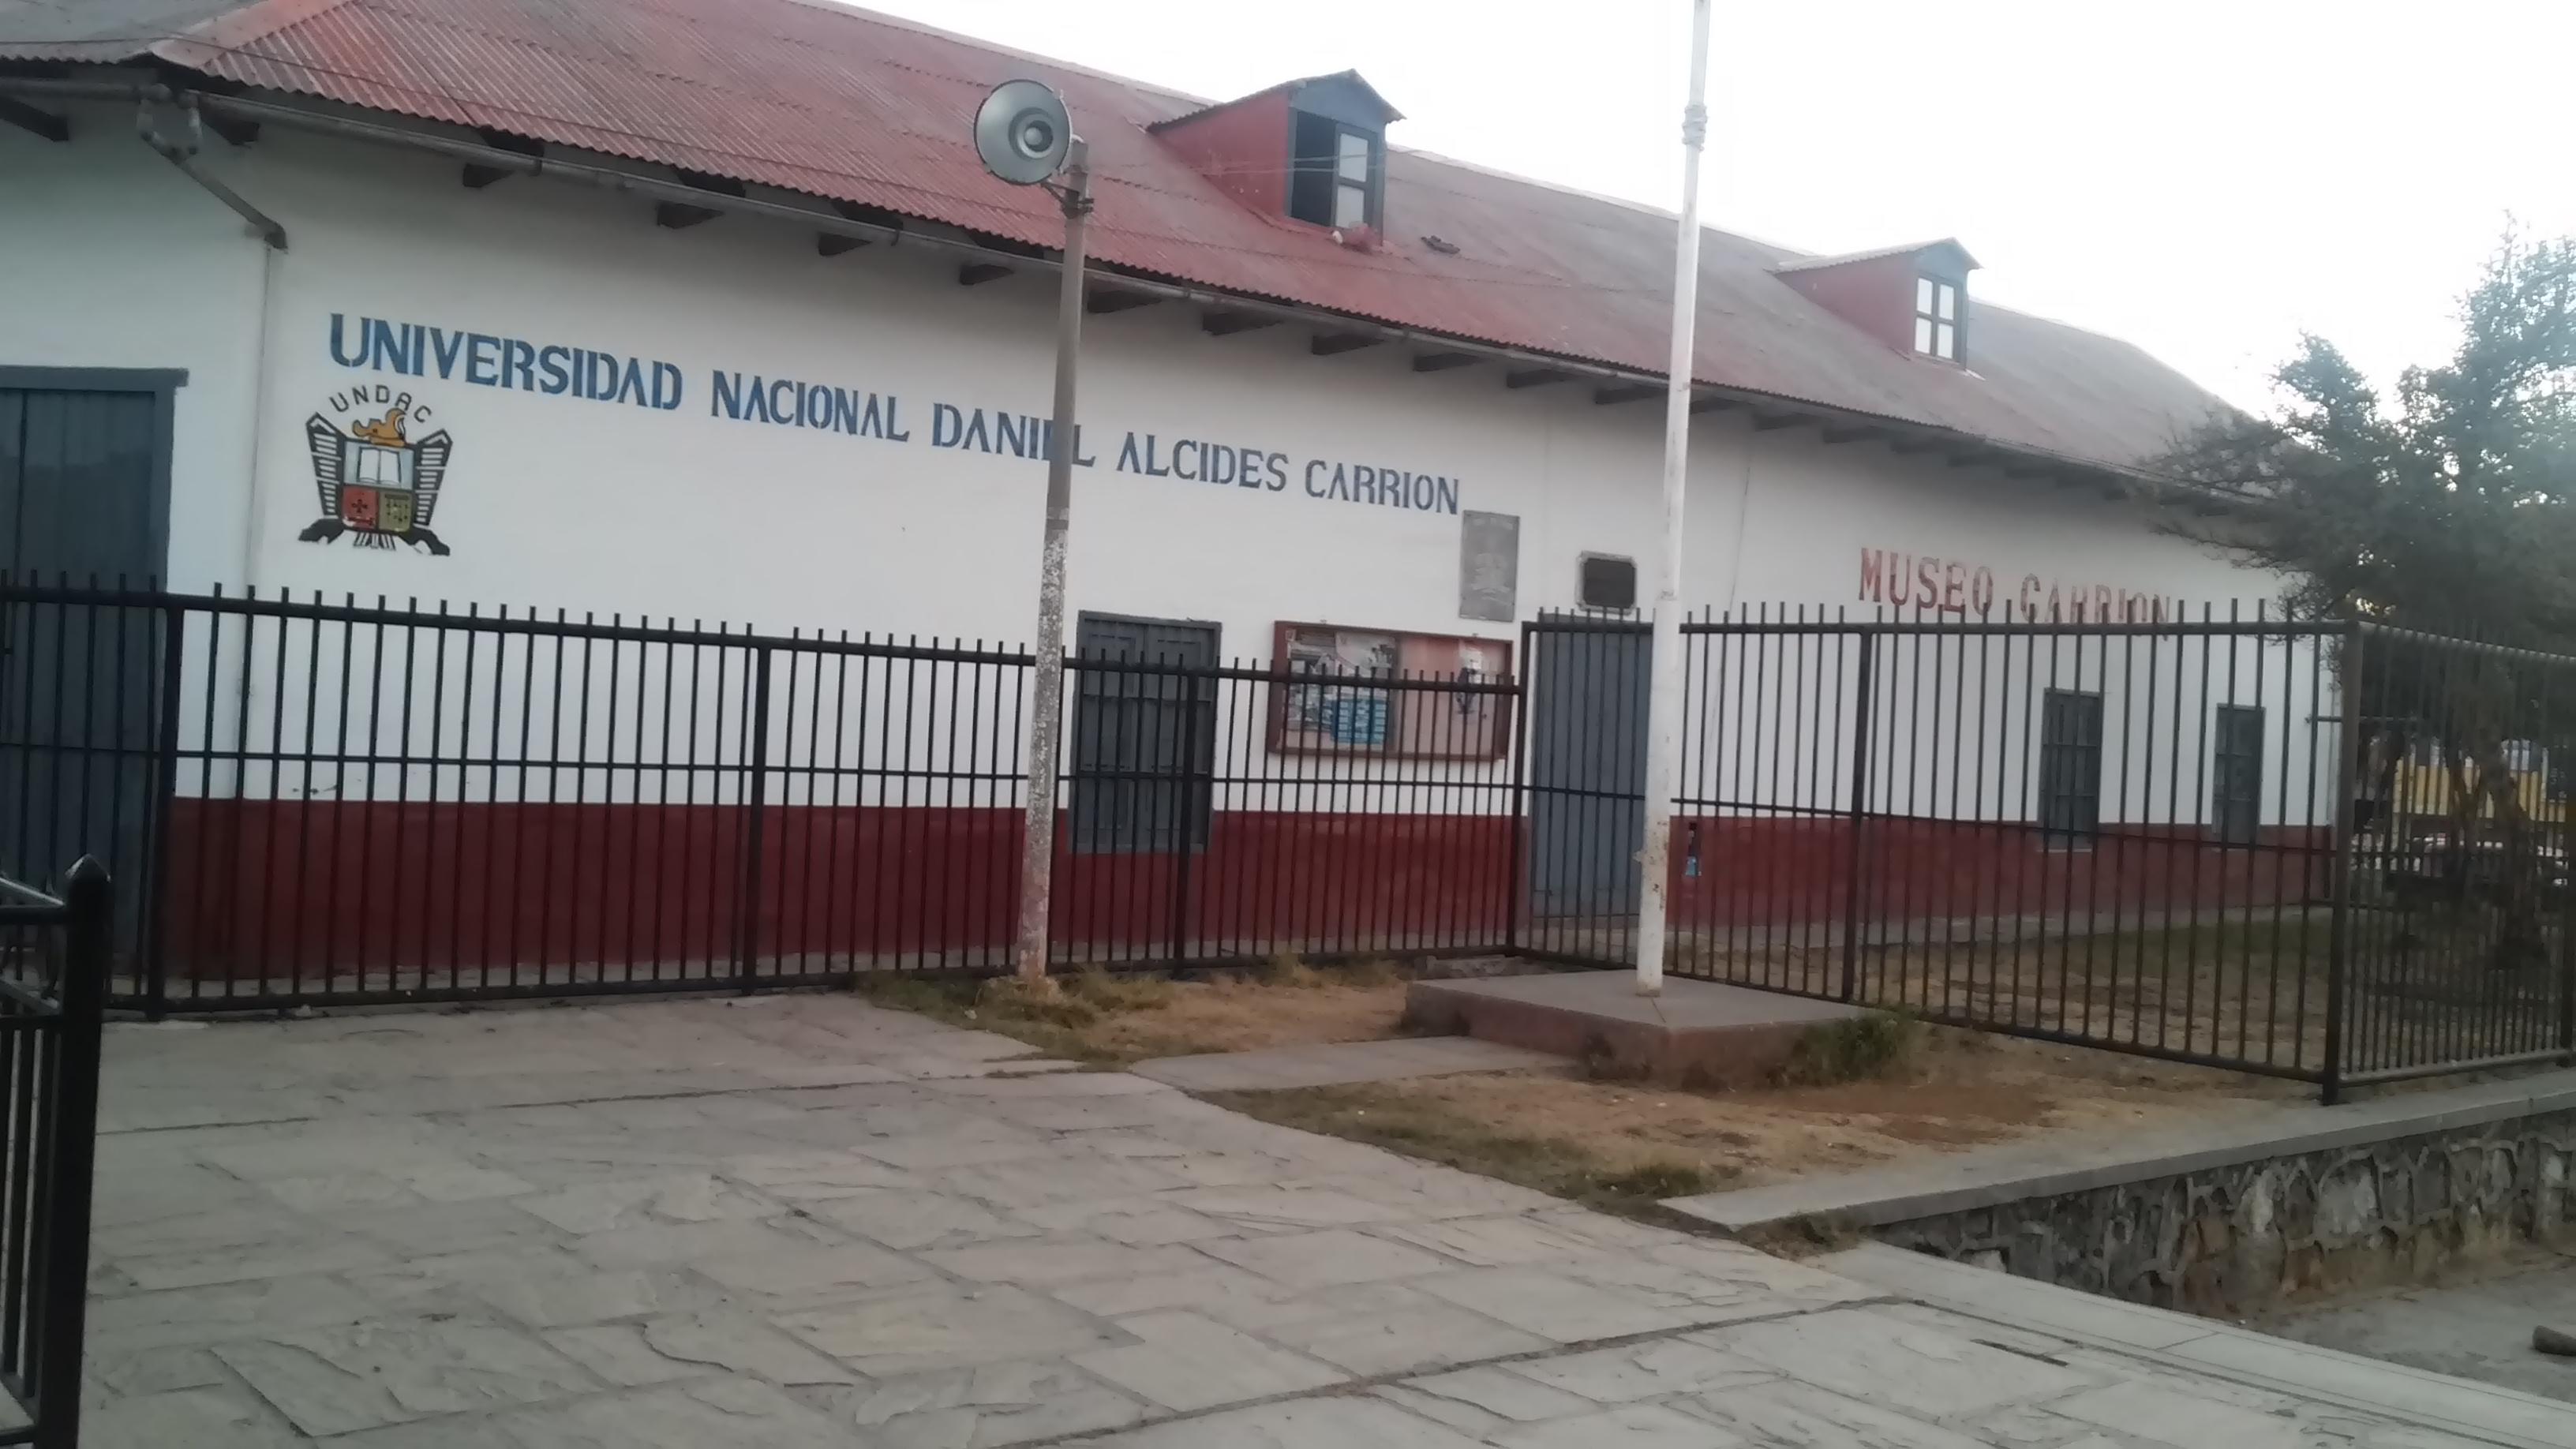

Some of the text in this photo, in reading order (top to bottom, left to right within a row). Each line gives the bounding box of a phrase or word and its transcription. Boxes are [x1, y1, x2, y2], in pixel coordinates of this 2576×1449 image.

[329, 384, 432, 424] UNDAC
[330, 313, 683, 410] UNIVERSIDAD
[711, 369, 911, 443] NACIONAL
[1116, 431, 1290, 492] ALCIDES
[1304, 459, 1459, 515] CARRION
[1858, 547, 1994, 616] MUSEO
